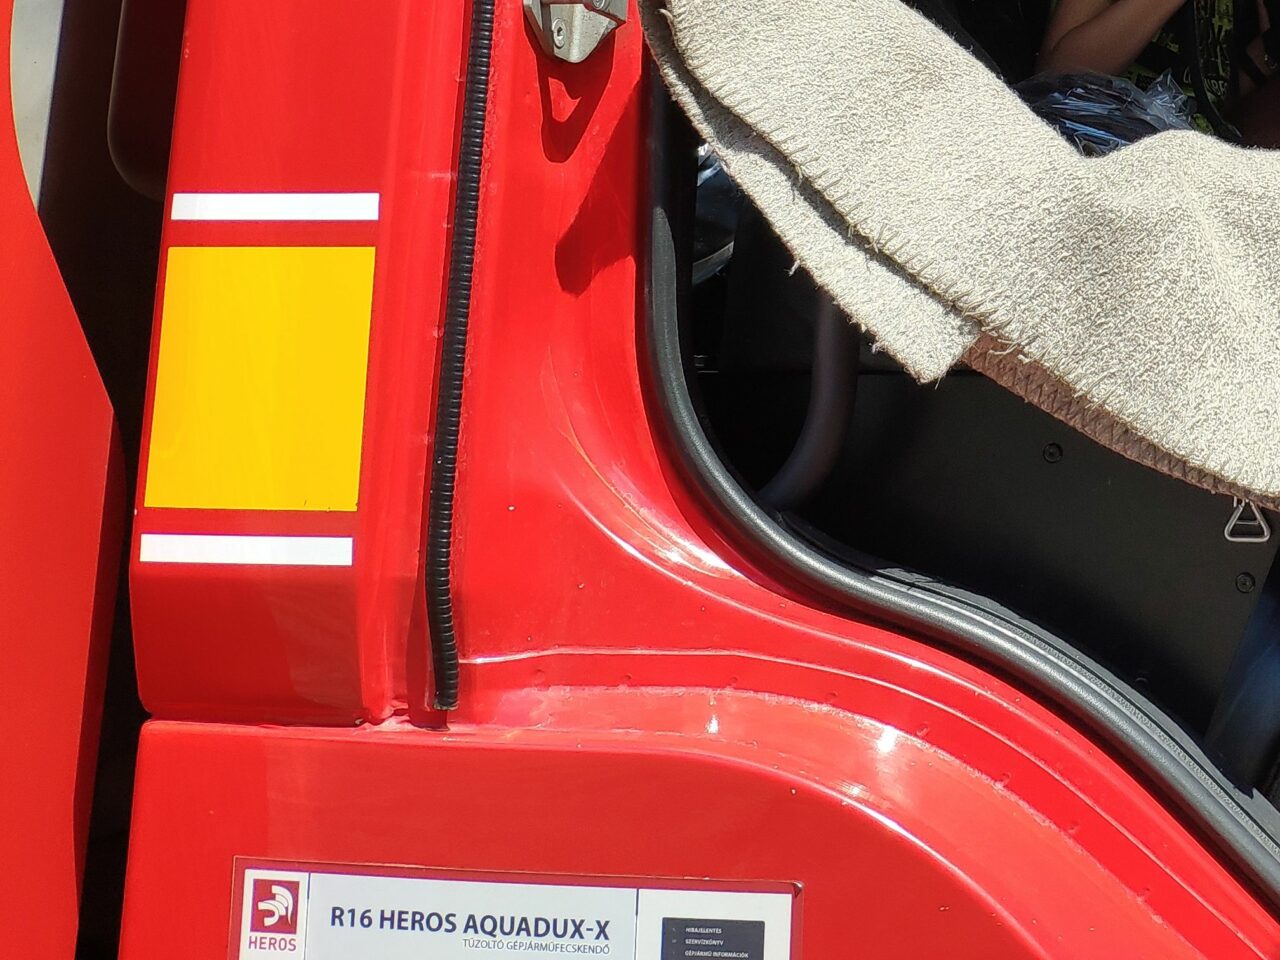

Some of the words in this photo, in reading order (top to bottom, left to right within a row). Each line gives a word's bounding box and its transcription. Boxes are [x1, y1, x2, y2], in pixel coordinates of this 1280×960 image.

[331, 906, 373, 928] R16
[379, 909, 457, 933] HEROS
[463, 914, 610, 940] AQUADUX-X
[248, 935, 297, 952] HEROS
